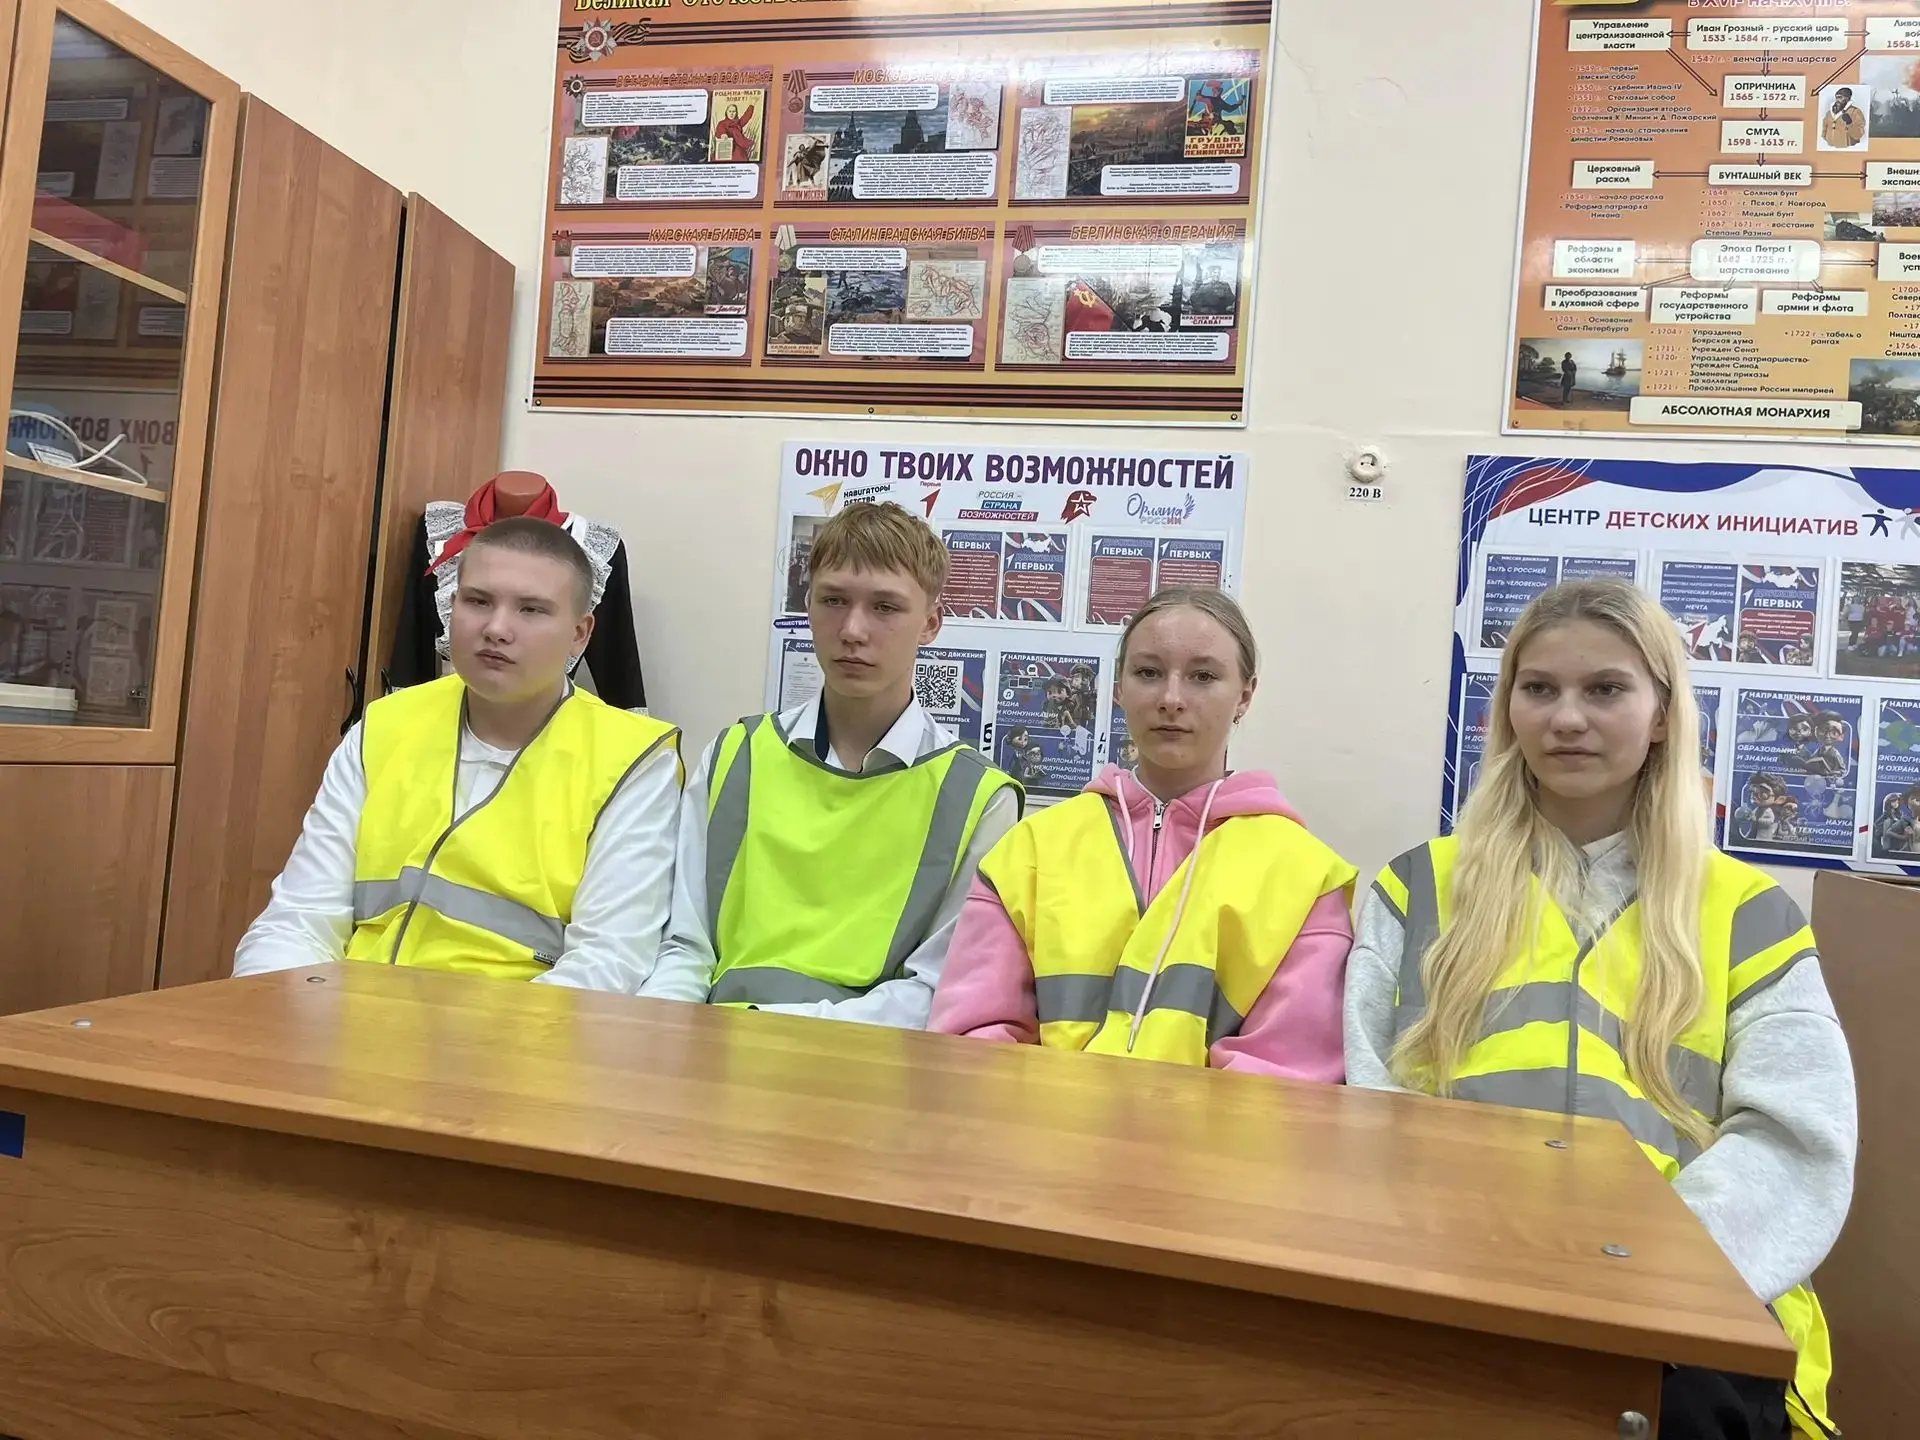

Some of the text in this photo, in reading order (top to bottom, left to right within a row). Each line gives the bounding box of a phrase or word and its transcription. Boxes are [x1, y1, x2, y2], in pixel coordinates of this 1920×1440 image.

[1592, 21, 1649, 30] Управление
[1724, 23, 1763, 33] Грозный
[1773, 24, 1812, 32] русский
[1576, 31, 1665, 40] централизованной
[1796, 56, 1837, 64] царство
[1734, 83, 1796, 91] ОПРИЧНИНА
[1730, 93, 1753, 101] 1565
[1763, 93, 1786, 101] 1572
[1745, 128, 1780, 136] СМУТА
[1587, 165, 1640, 174] Церковный
[1887, 167, 1920, 175] Внешн
[1596, 176, 1630, 184] раскол
[1718, 171, 1802, 180] БУНТАШНЫЙ ВЕК
[649, 228, 756, 242] КУРСКАЯ БИТВА
[830, 227, 987, 243] СТАЛИНГРАДСКАЯ БИТВА
[1070, 225, 1236, 242] БЕРЛИНСКАЯ ОПЕРАЦИЯ
[1567, 245, 1614, 254] Реформы
[1720, 244, 1785, 254] Эпоха Петра
[1574, 256, 1614, 264] области
[1719, 267, 1790, 276] царствование
[1555, 289, 1638, 298] Преобразования
[1680, 291, 1729, 300] Реформы
[1792, 292, 1841, 302] Реформы
[1560, 299, 1603, 309] духовной
[1606, 299, 1640, 309] сфере
[1659, 302, 1749, 311] государственного
[1777, 304, 1810, 312] армии
[1822, 304, 1854, 313] флота
[1675, 311, 1732, 321] устройства
[1662, 404, 1830, 418] АБСОЛЮТНАЯ МОНАРХИЯ
[795, 448, 1234, 490] ОКНО ТВОИХ ВОЗМОЖНОСТЕЙ
[843, 484, 891, 499] НАВИГАТОРЫ
[978, 490, 1014, 499] РОССИЯ
[1349, 487, 1382, 498] 220 В
[983, 501, 1019, 509] СТРАНА
[1127, 493, 1182, 518] Орлята
[960, 510, 1036, 521] ВОЗМОЖНОСТЕЙ
[1140, 516, 1182, 525] РОССИИ
[1528, 508, 1859, 536] ЦЕНТР ДЕТСКИХ ИНИЦИАТИВ
[952, 541, 991, 550] ПЕРВЫХ
[1102, 547, 1143, 556] ПЕРВЫХ
[1169, 550, 1211, 559] ПЕРВЫХ
[1014, 562, 1054, 571] ПЕРВЫХ
[1754, 598, 1803, 609] ПЕРВЫХ
[1007, 654, 1098, 665] НАПРАВЛЕНИЯ ДВИЖЕНИЯ
[1749, 691, 1861, 705] НАПРАВЛЕНИЯ ДВИЖЕНИЯ
[1002, 710, 1059, 719] КОММУНИКАЦИИ
[1042, 757, 1085, 766] ДИПЛОМАТИЯ
[1744, 755, 1778, 763] ЗНАНИЯ
[1825, 819, 1853, 827] НАУКА
[1798, 827, 1853, 837] ТЕХНОЛОГИИ
